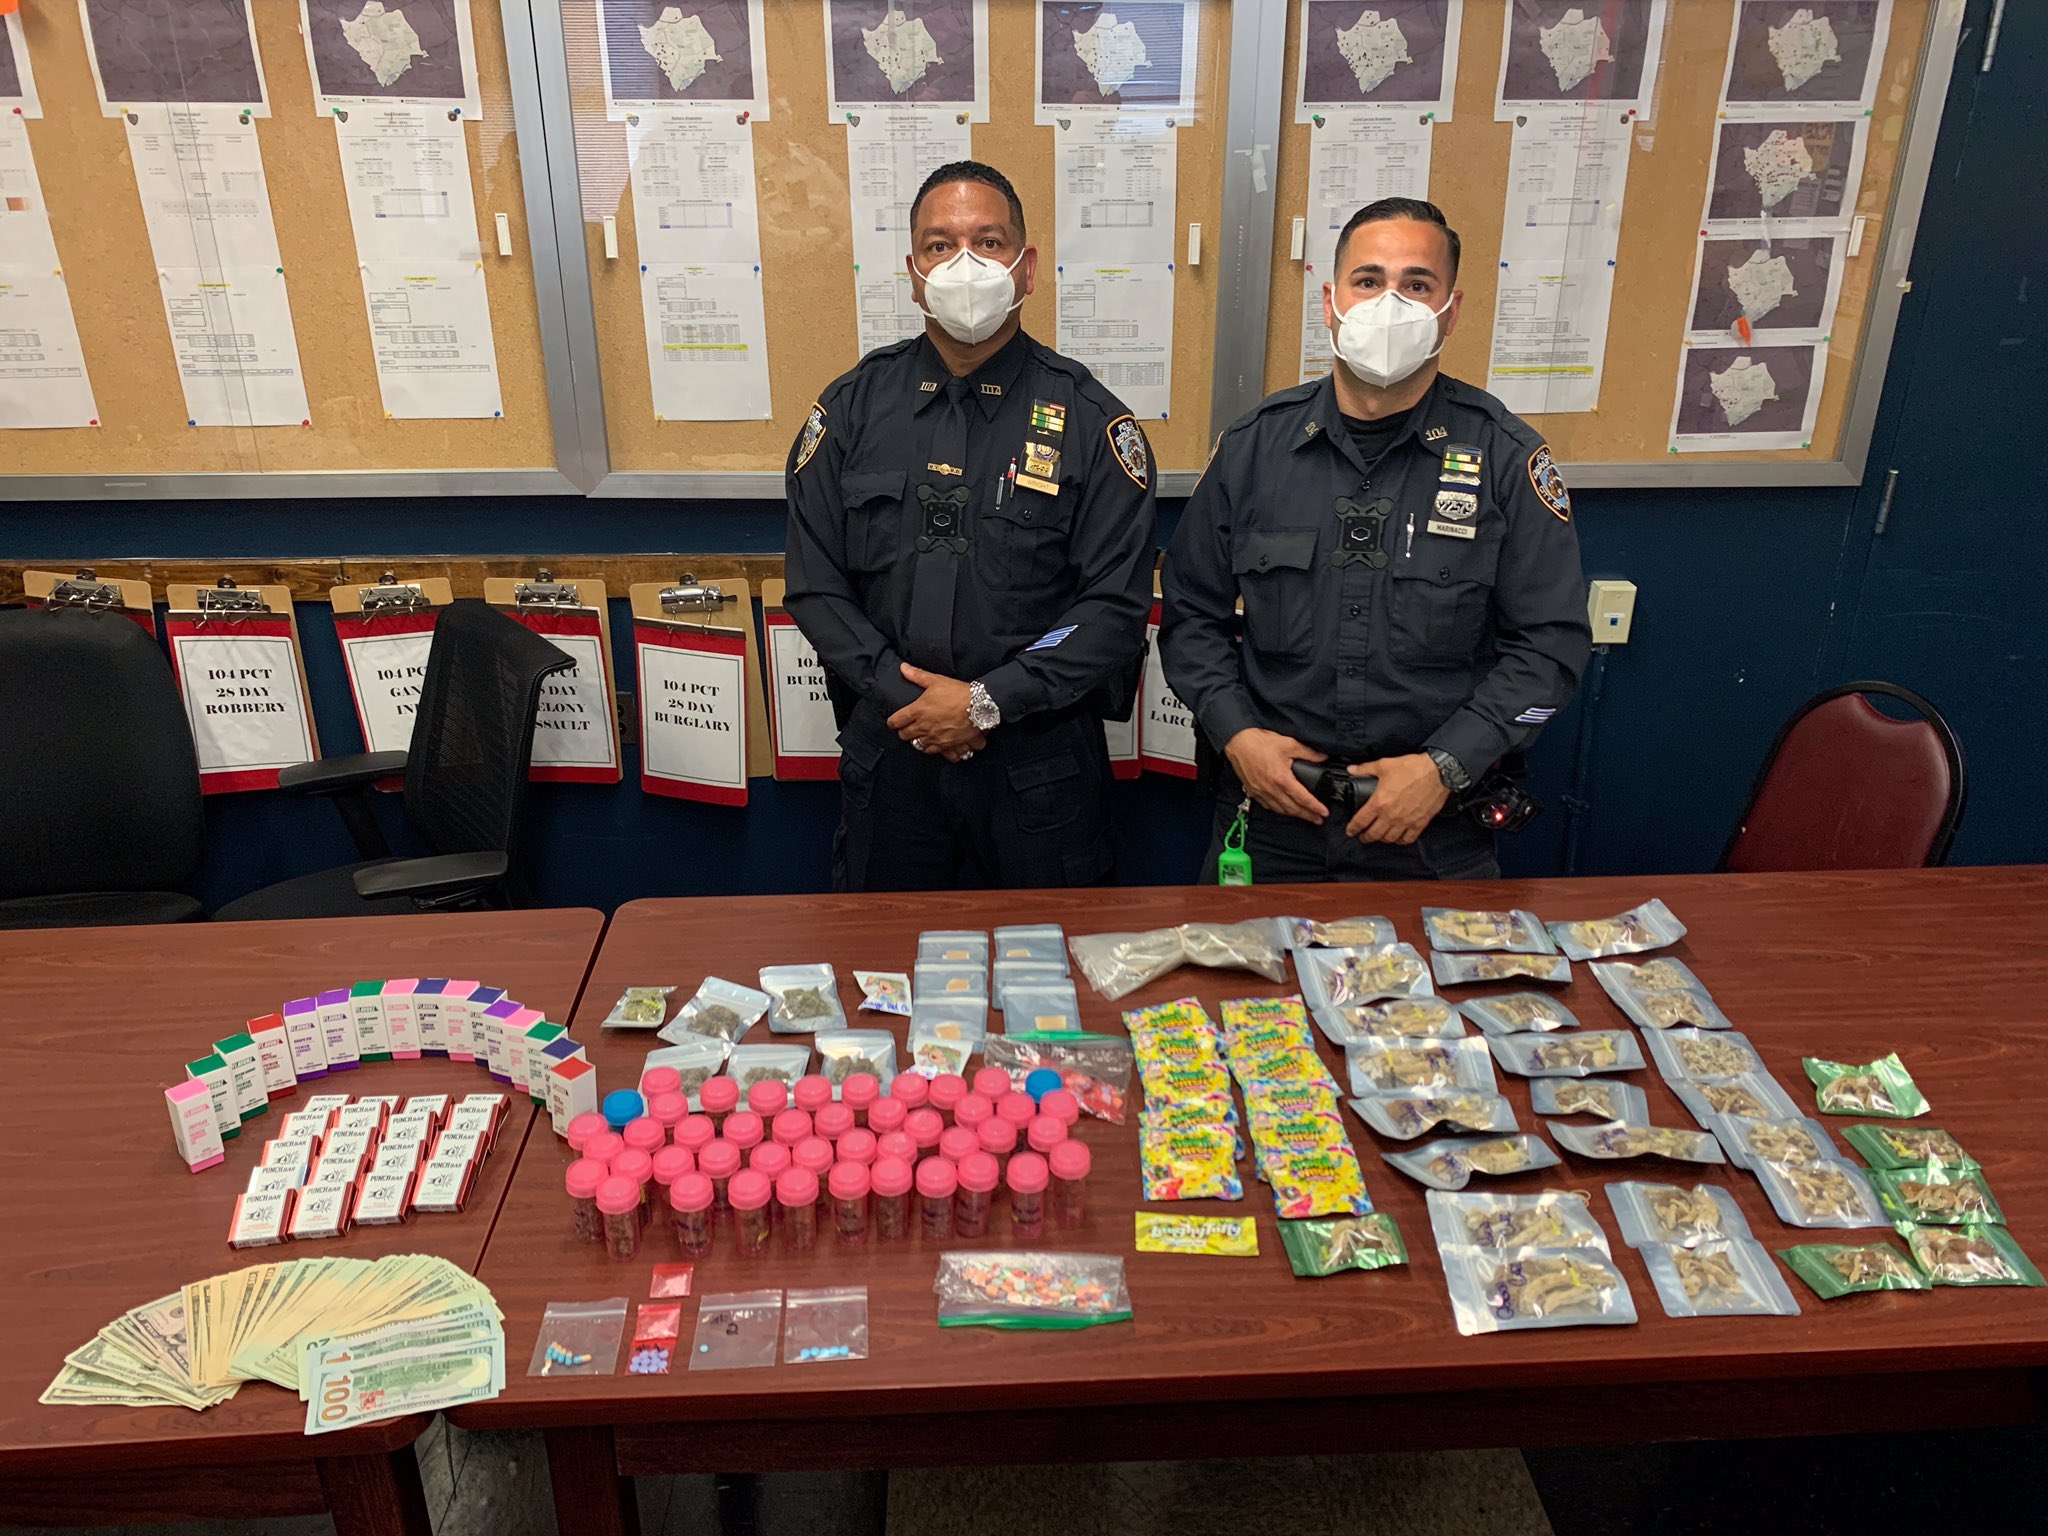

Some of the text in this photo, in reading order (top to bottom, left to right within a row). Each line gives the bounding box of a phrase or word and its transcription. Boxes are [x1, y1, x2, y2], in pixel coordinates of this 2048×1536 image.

[1426, 426, 1448, 440] 104
[1436, 524, 1468, 535] MARINACCI
[207, 668, 272, 680] 104 PCT
[377, 665, 428, 681] 104 PC
[216, 686, 271, 698] 28 DAY
[390, 685, 422, 697] GAN
[549, 685, 578, 696] DAY
[663, 679, 720, 697] 104 PCT
[809, 691, 829, 702] DA
[538, 702, 586, 713] ELONY
[668, 699, 716, 714] 28 DAY
[1161, 696, 1182, 710] GR
[205, 702, 287, 716] ROBBERY
[397, 704, 415, 715] IN
[654, 711, 733, 733] BURGLARY
[1150, 710, 1191, 727] LARC
[535, 719, 591, 730] SSAULT
[345, 1106, 364, 1114] PUNCH
[393, 1116, 413, 1124] PUNCH
[273, 1141, 294, 1149] PUNCH
[262, 1166, 283, 1174] PUNCH
[307, 1187, 328, 1195] PUNCH
[246, 1195, 268, 1203] PUNCH
[321, 1374, 352, 1422] 100
